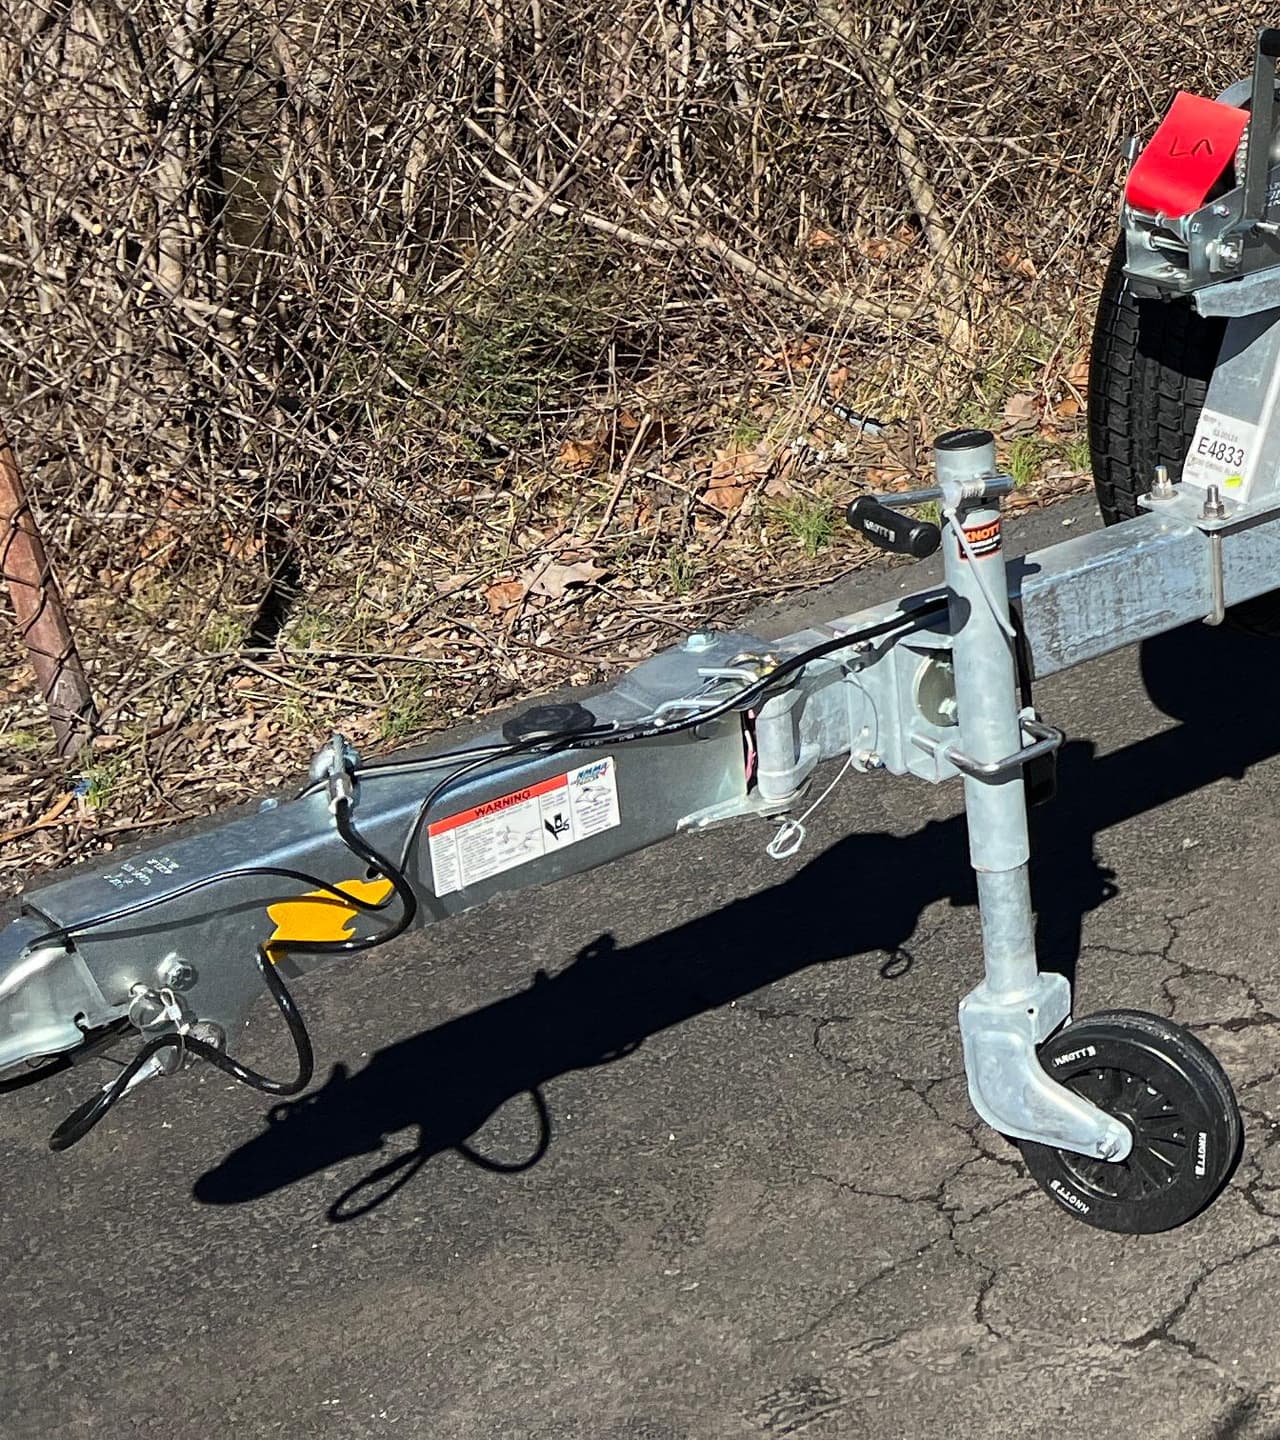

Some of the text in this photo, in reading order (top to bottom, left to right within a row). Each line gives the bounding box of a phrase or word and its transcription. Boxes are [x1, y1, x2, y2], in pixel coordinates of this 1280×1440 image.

[1197, 436, 1245, 467] E4833
[964, 521, 1000, 542] KNOTT
[474, 789, 531, 817] WARNING
[1054, 1047, 1087, 1066] KNOTT
[1197, 1131, 1207, 1169] KNOTT
[1056, 1187, 1090, 1214] KNOTT
